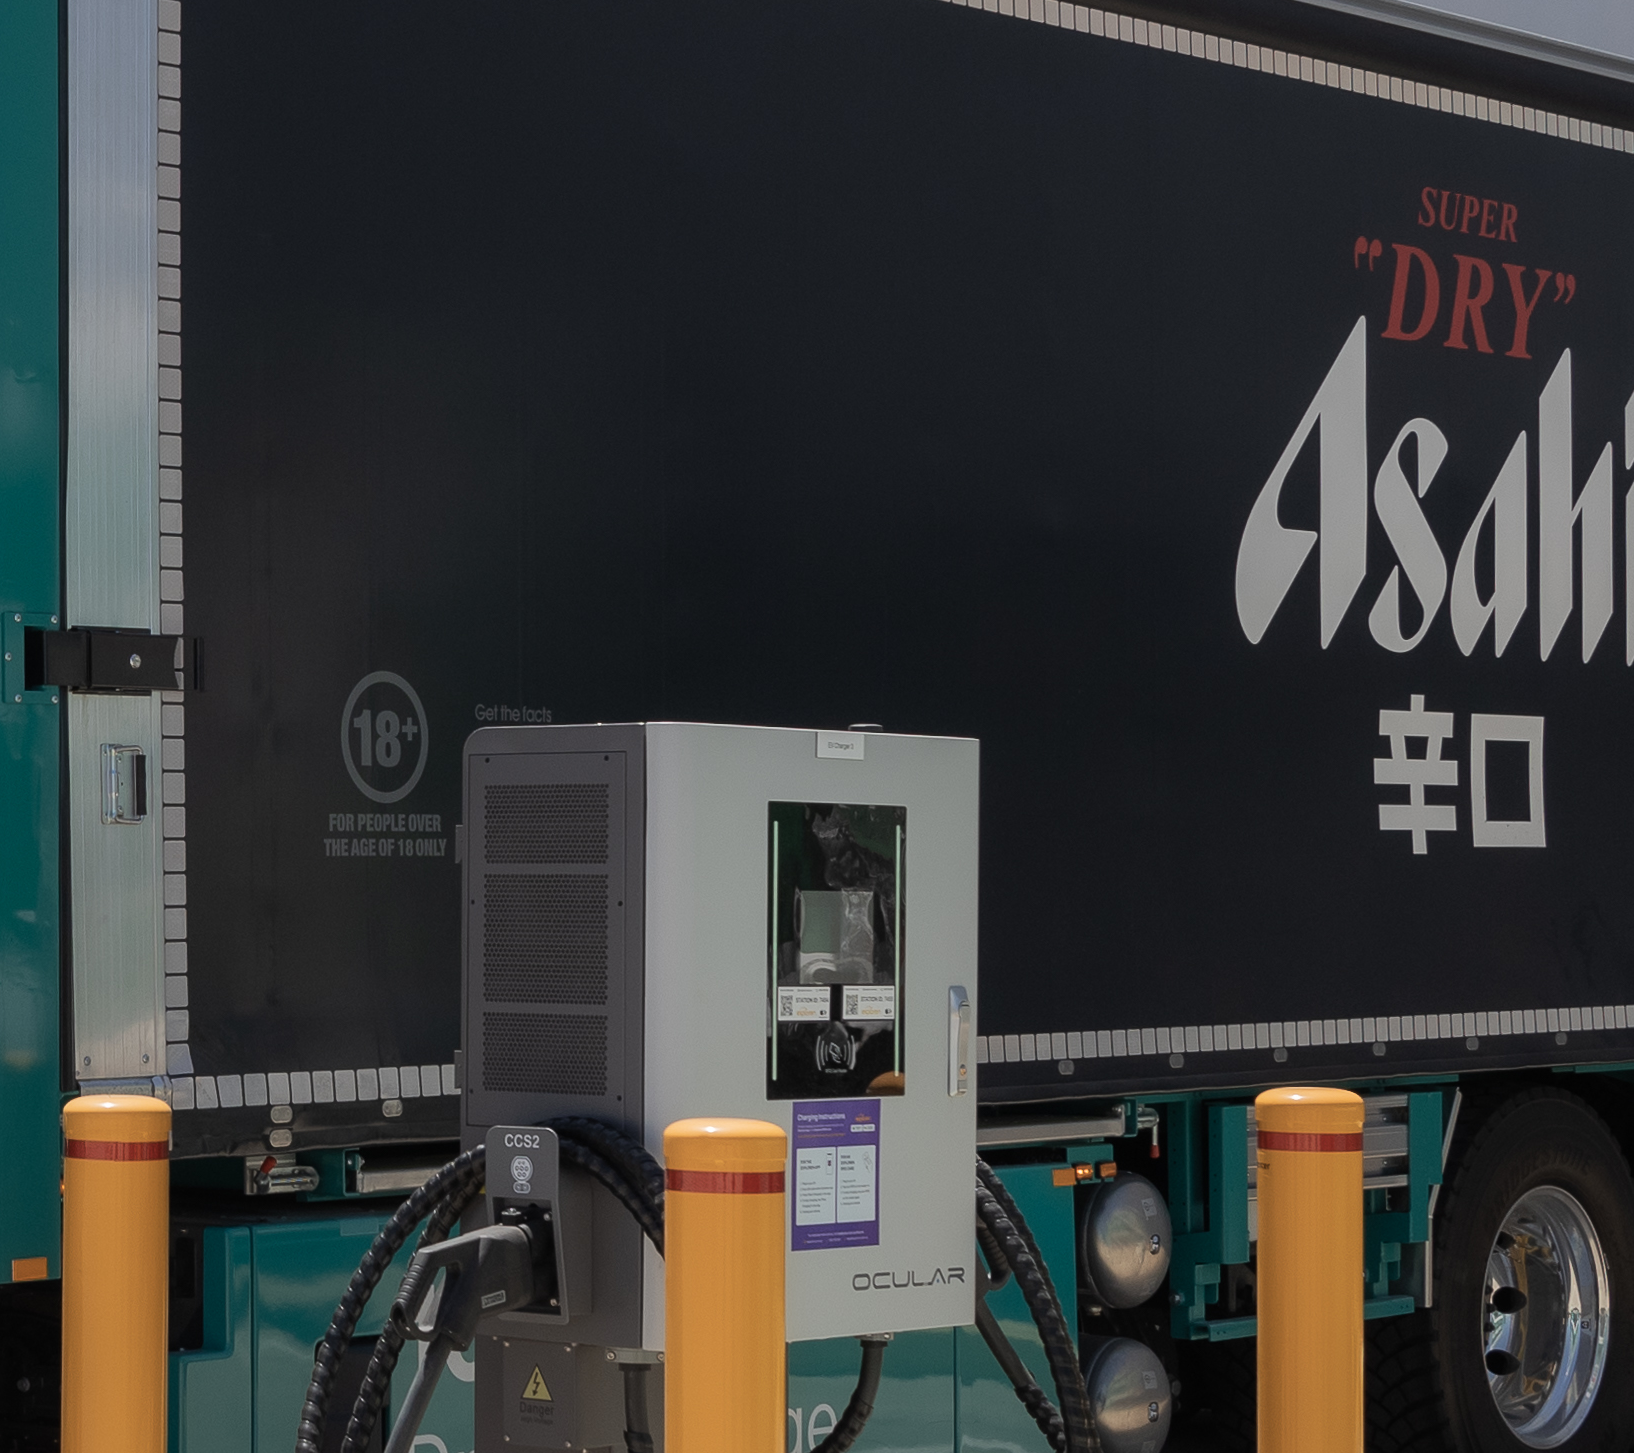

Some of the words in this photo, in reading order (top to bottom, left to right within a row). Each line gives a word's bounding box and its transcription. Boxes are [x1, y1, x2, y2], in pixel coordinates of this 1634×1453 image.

[1417, 185, 1519, 243] SUPER
[474, 703, 499, 721] Get
[500, 705, 520, 722] the
[522, 706, 552, 724] facts
[353, 708, 419, 768] 18+
[1373, 693, 1547, 855] 辛口
[328, 813, 355, 832] FOR
[357, 813, 406, 833] PEOPLE
[408, 814, 442, 833] OVER
[324, 838, 349, 856] THE
[350, 838, 377, 856] AGE
[378, 838, 395, 856] OF
[397, 838, 413, 856] 18
[415, 838, 447, 857] ONLY
[504, 1133, 540, 1149] CCS2
[852, 1267, 965, 1291] OCULAR
[519, 1401, 554, 1418] Danger
